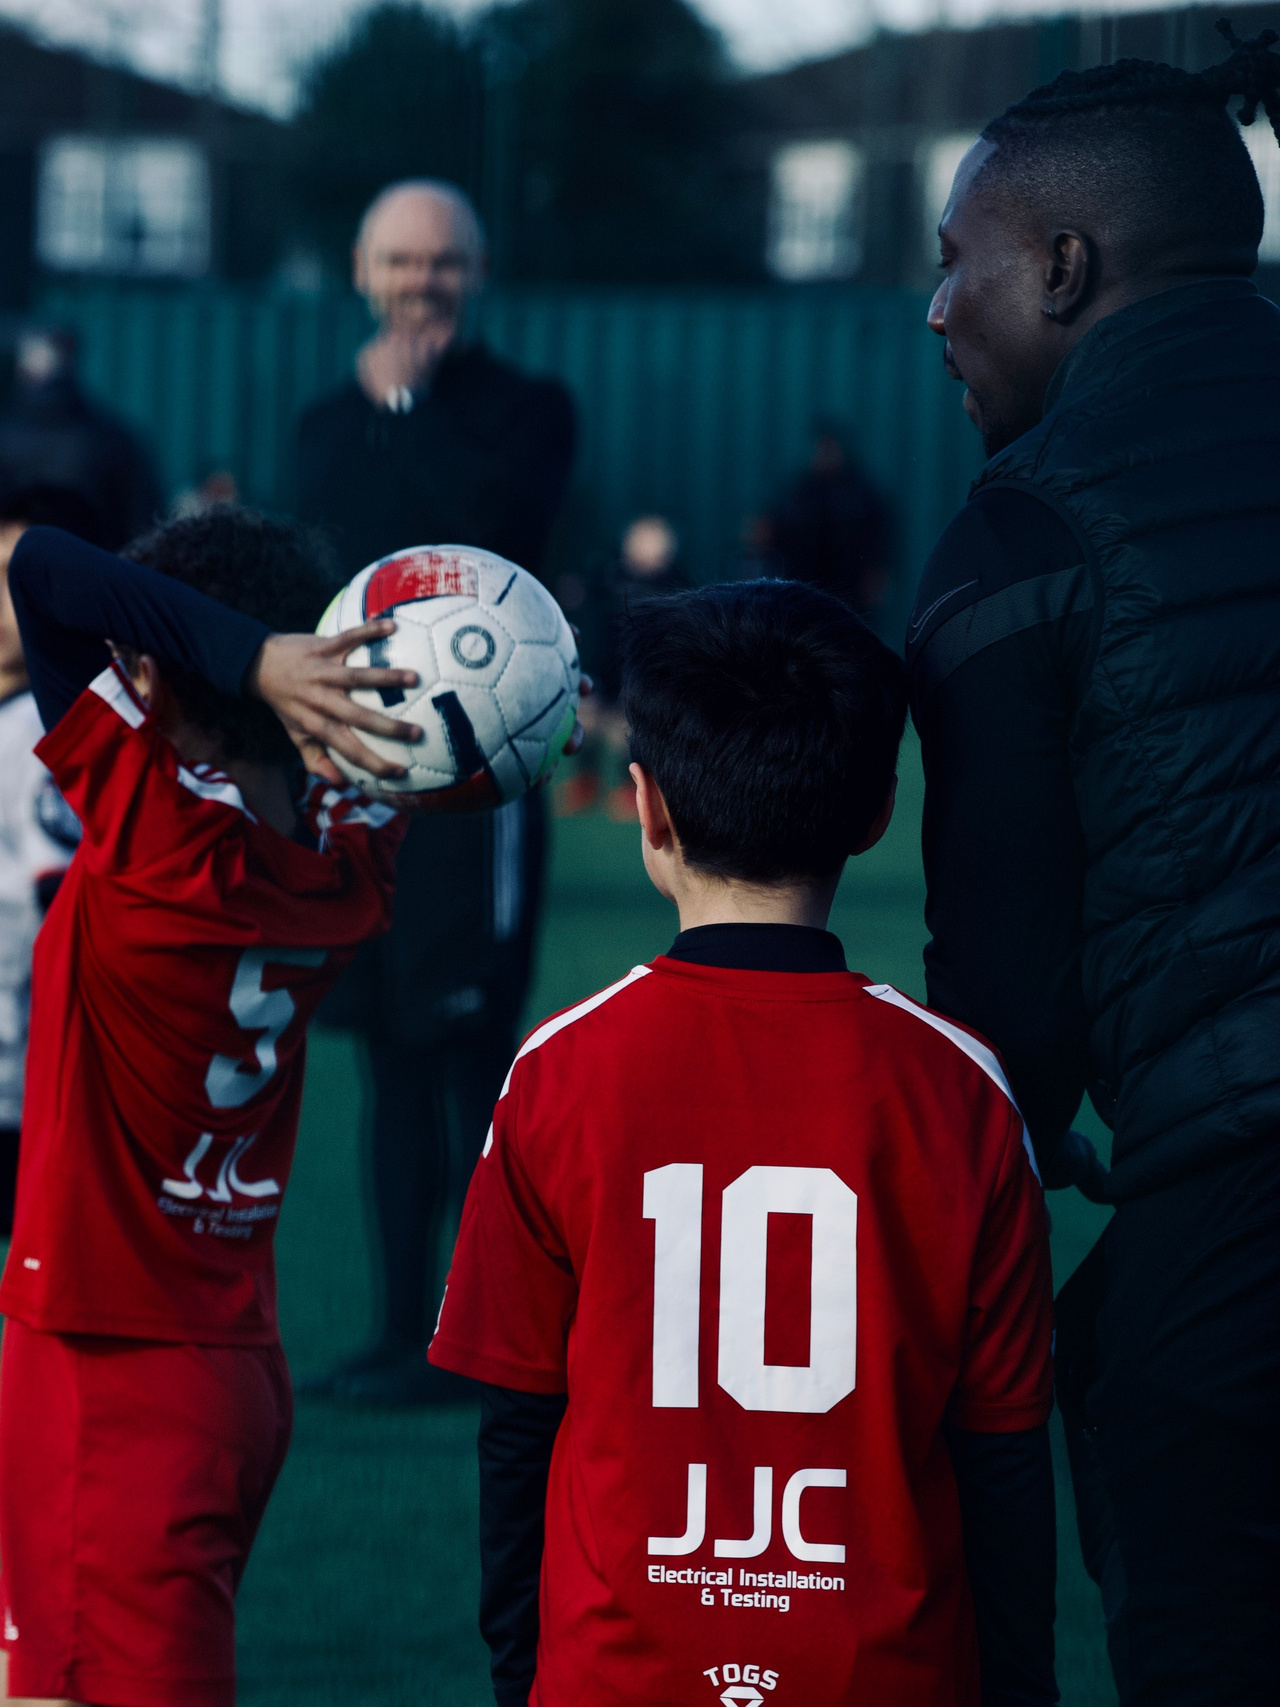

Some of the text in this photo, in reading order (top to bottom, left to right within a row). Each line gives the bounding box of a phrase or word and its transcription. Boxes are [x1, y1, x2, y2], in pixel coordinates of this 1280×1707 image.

[205, 946, 329, 1107] 5
[642, 1162, 858, 1414] 10
[648, 1463, 847, 1564] JJC
[647, 1565, 845, 1590] Electrical Installation
[701, 1588, 790, 1612] & Testing
[702, 1663, 780, 1691] TOGS
